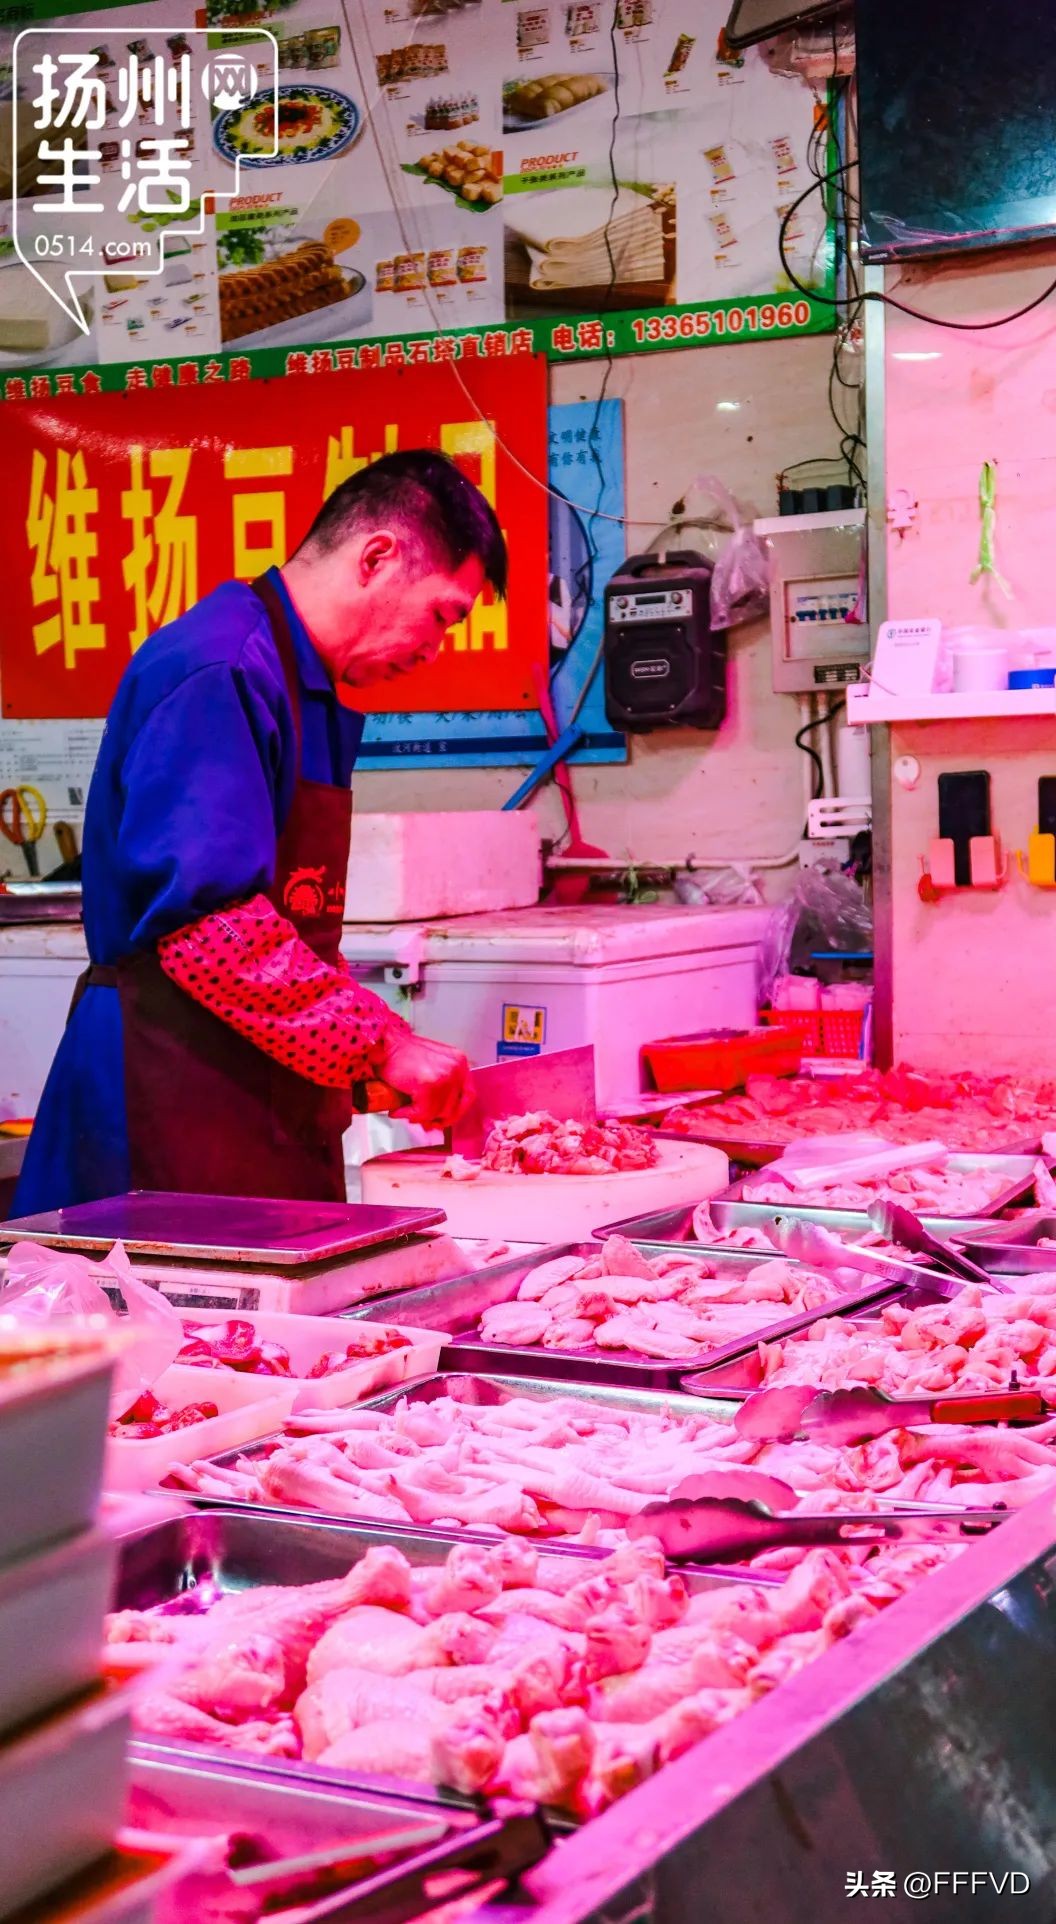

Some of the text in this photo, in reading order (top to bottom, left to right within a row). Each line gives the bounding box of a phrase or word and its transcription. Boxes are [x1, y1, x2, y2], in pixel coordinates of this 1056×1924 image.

[520, 151, 579, 169] PRODUCT
[229, 191, 283, 207] PRODUCT
[285, 328, 534, 377] 维扬豆制品石塔直销店
[632, 301, 811, 343] 13365101960
